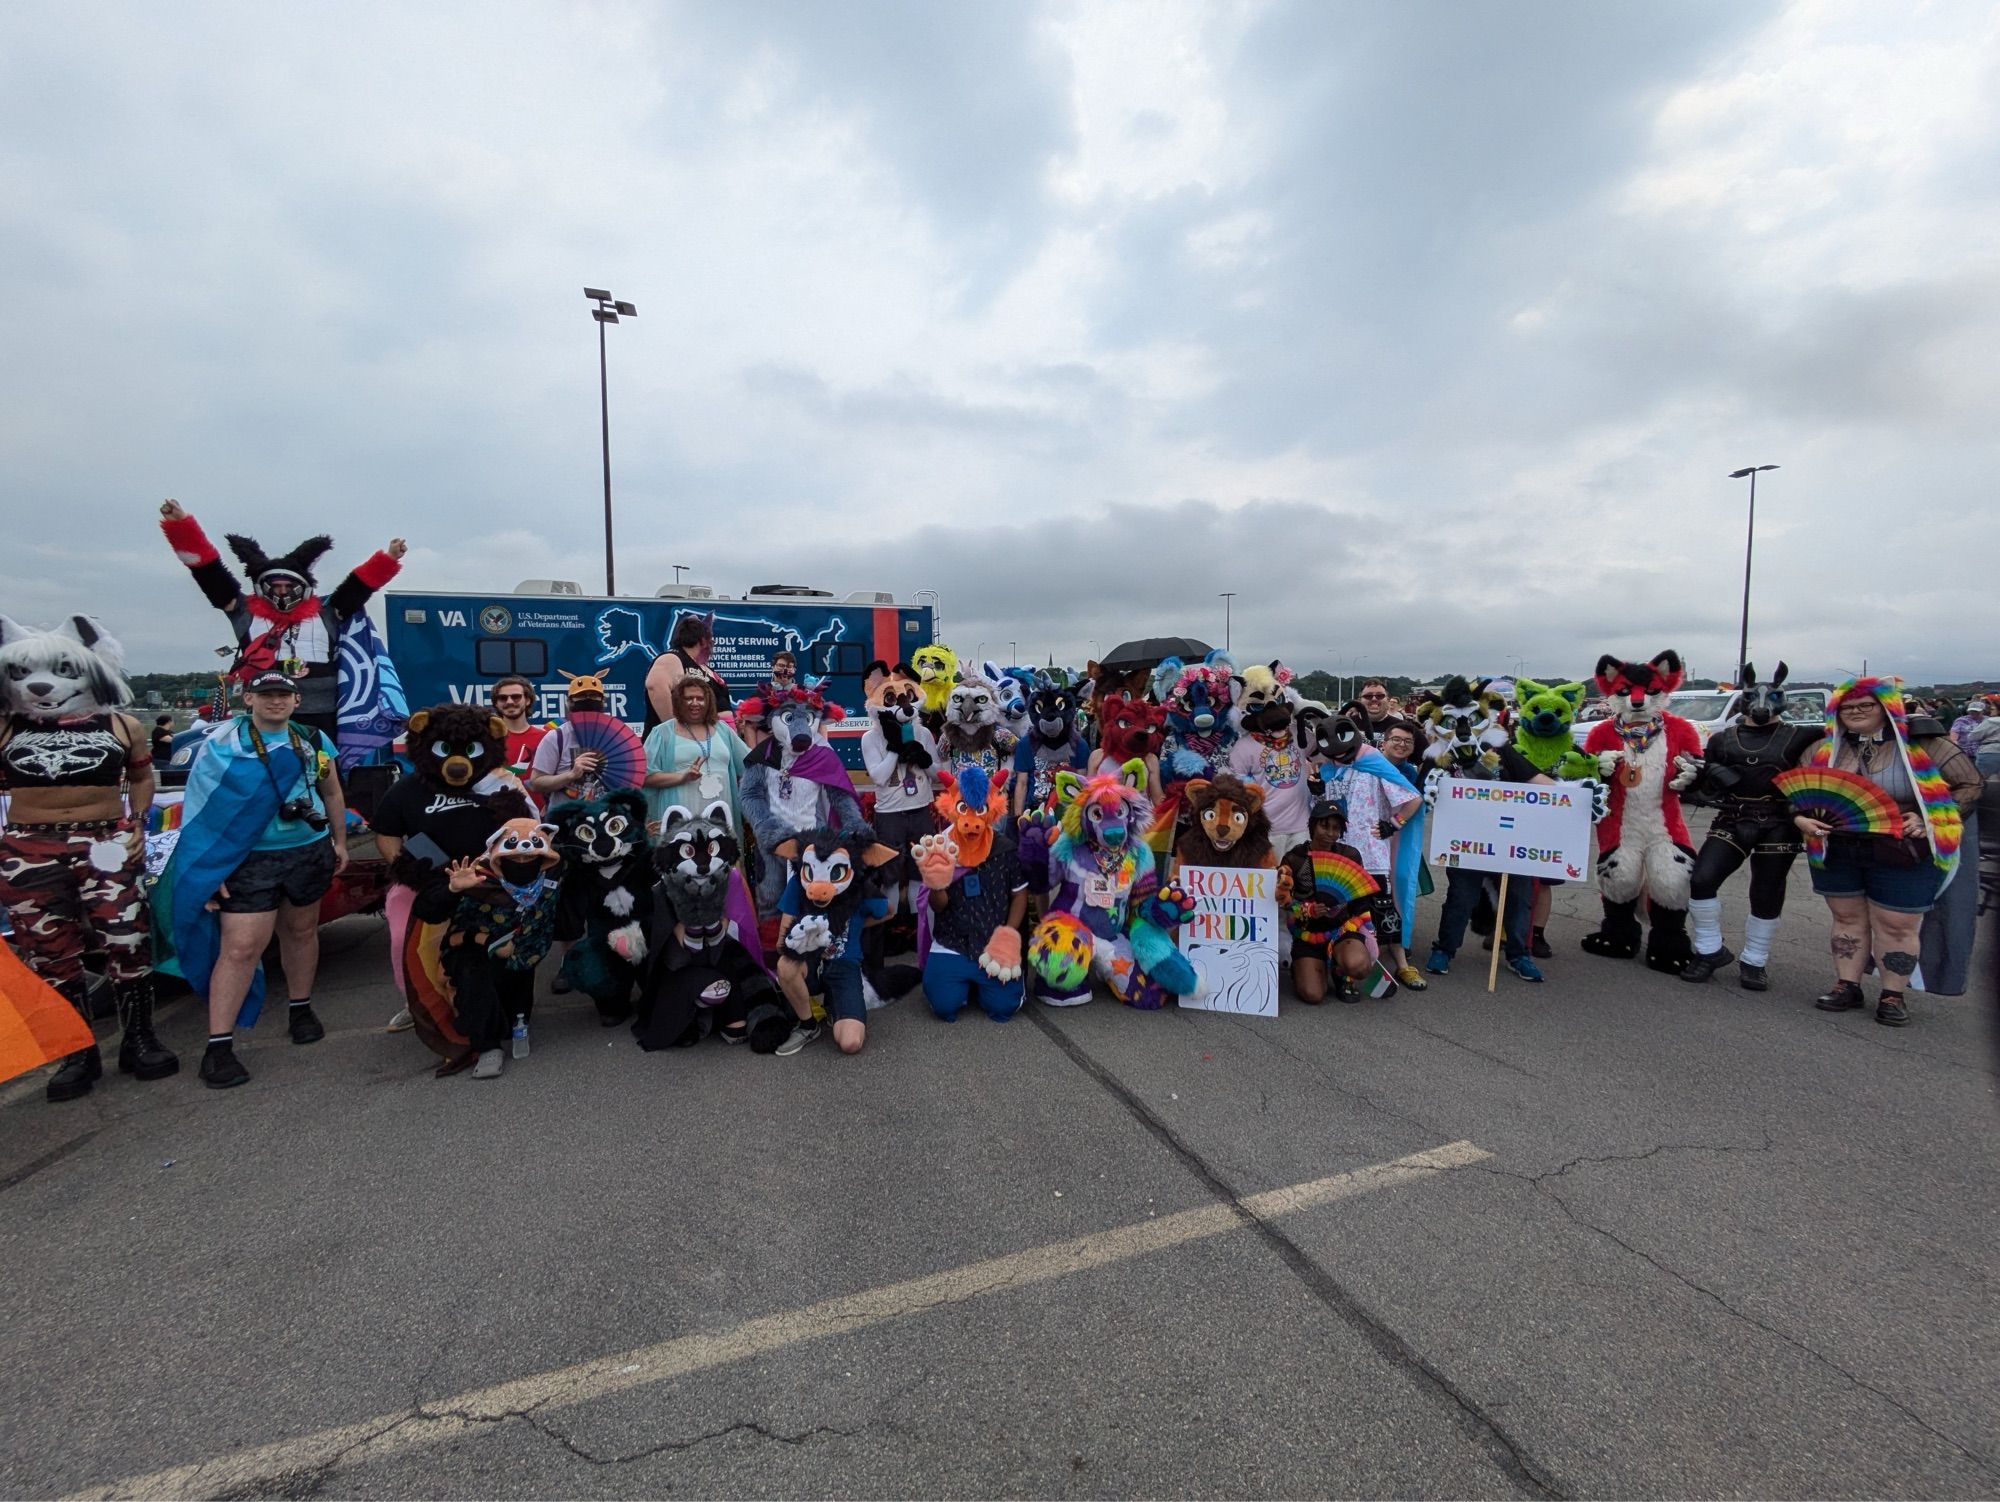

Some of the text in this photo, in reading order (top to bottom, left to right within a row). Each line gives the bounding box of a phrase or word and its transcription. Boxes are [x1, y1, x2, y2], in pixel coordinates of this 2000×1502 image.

[438, 610, 467, 627] VA
[518, 612, 579, 622] U.S. Department
[560, 621, 586, 629] Affairs
[738, 637, 779, 646] SERVING
[834, 720, 870, 728] RESERVE
[1452, 786, 1572, 807] HOMOPHOBIA
[1450, 839, 1563, 863] SKILL ISSUE
[1188, 869, 1268, 899] ROAR
[1201, 896, 1254, 914] WITH
[1188, 913, 1268, 942] PRIDE
